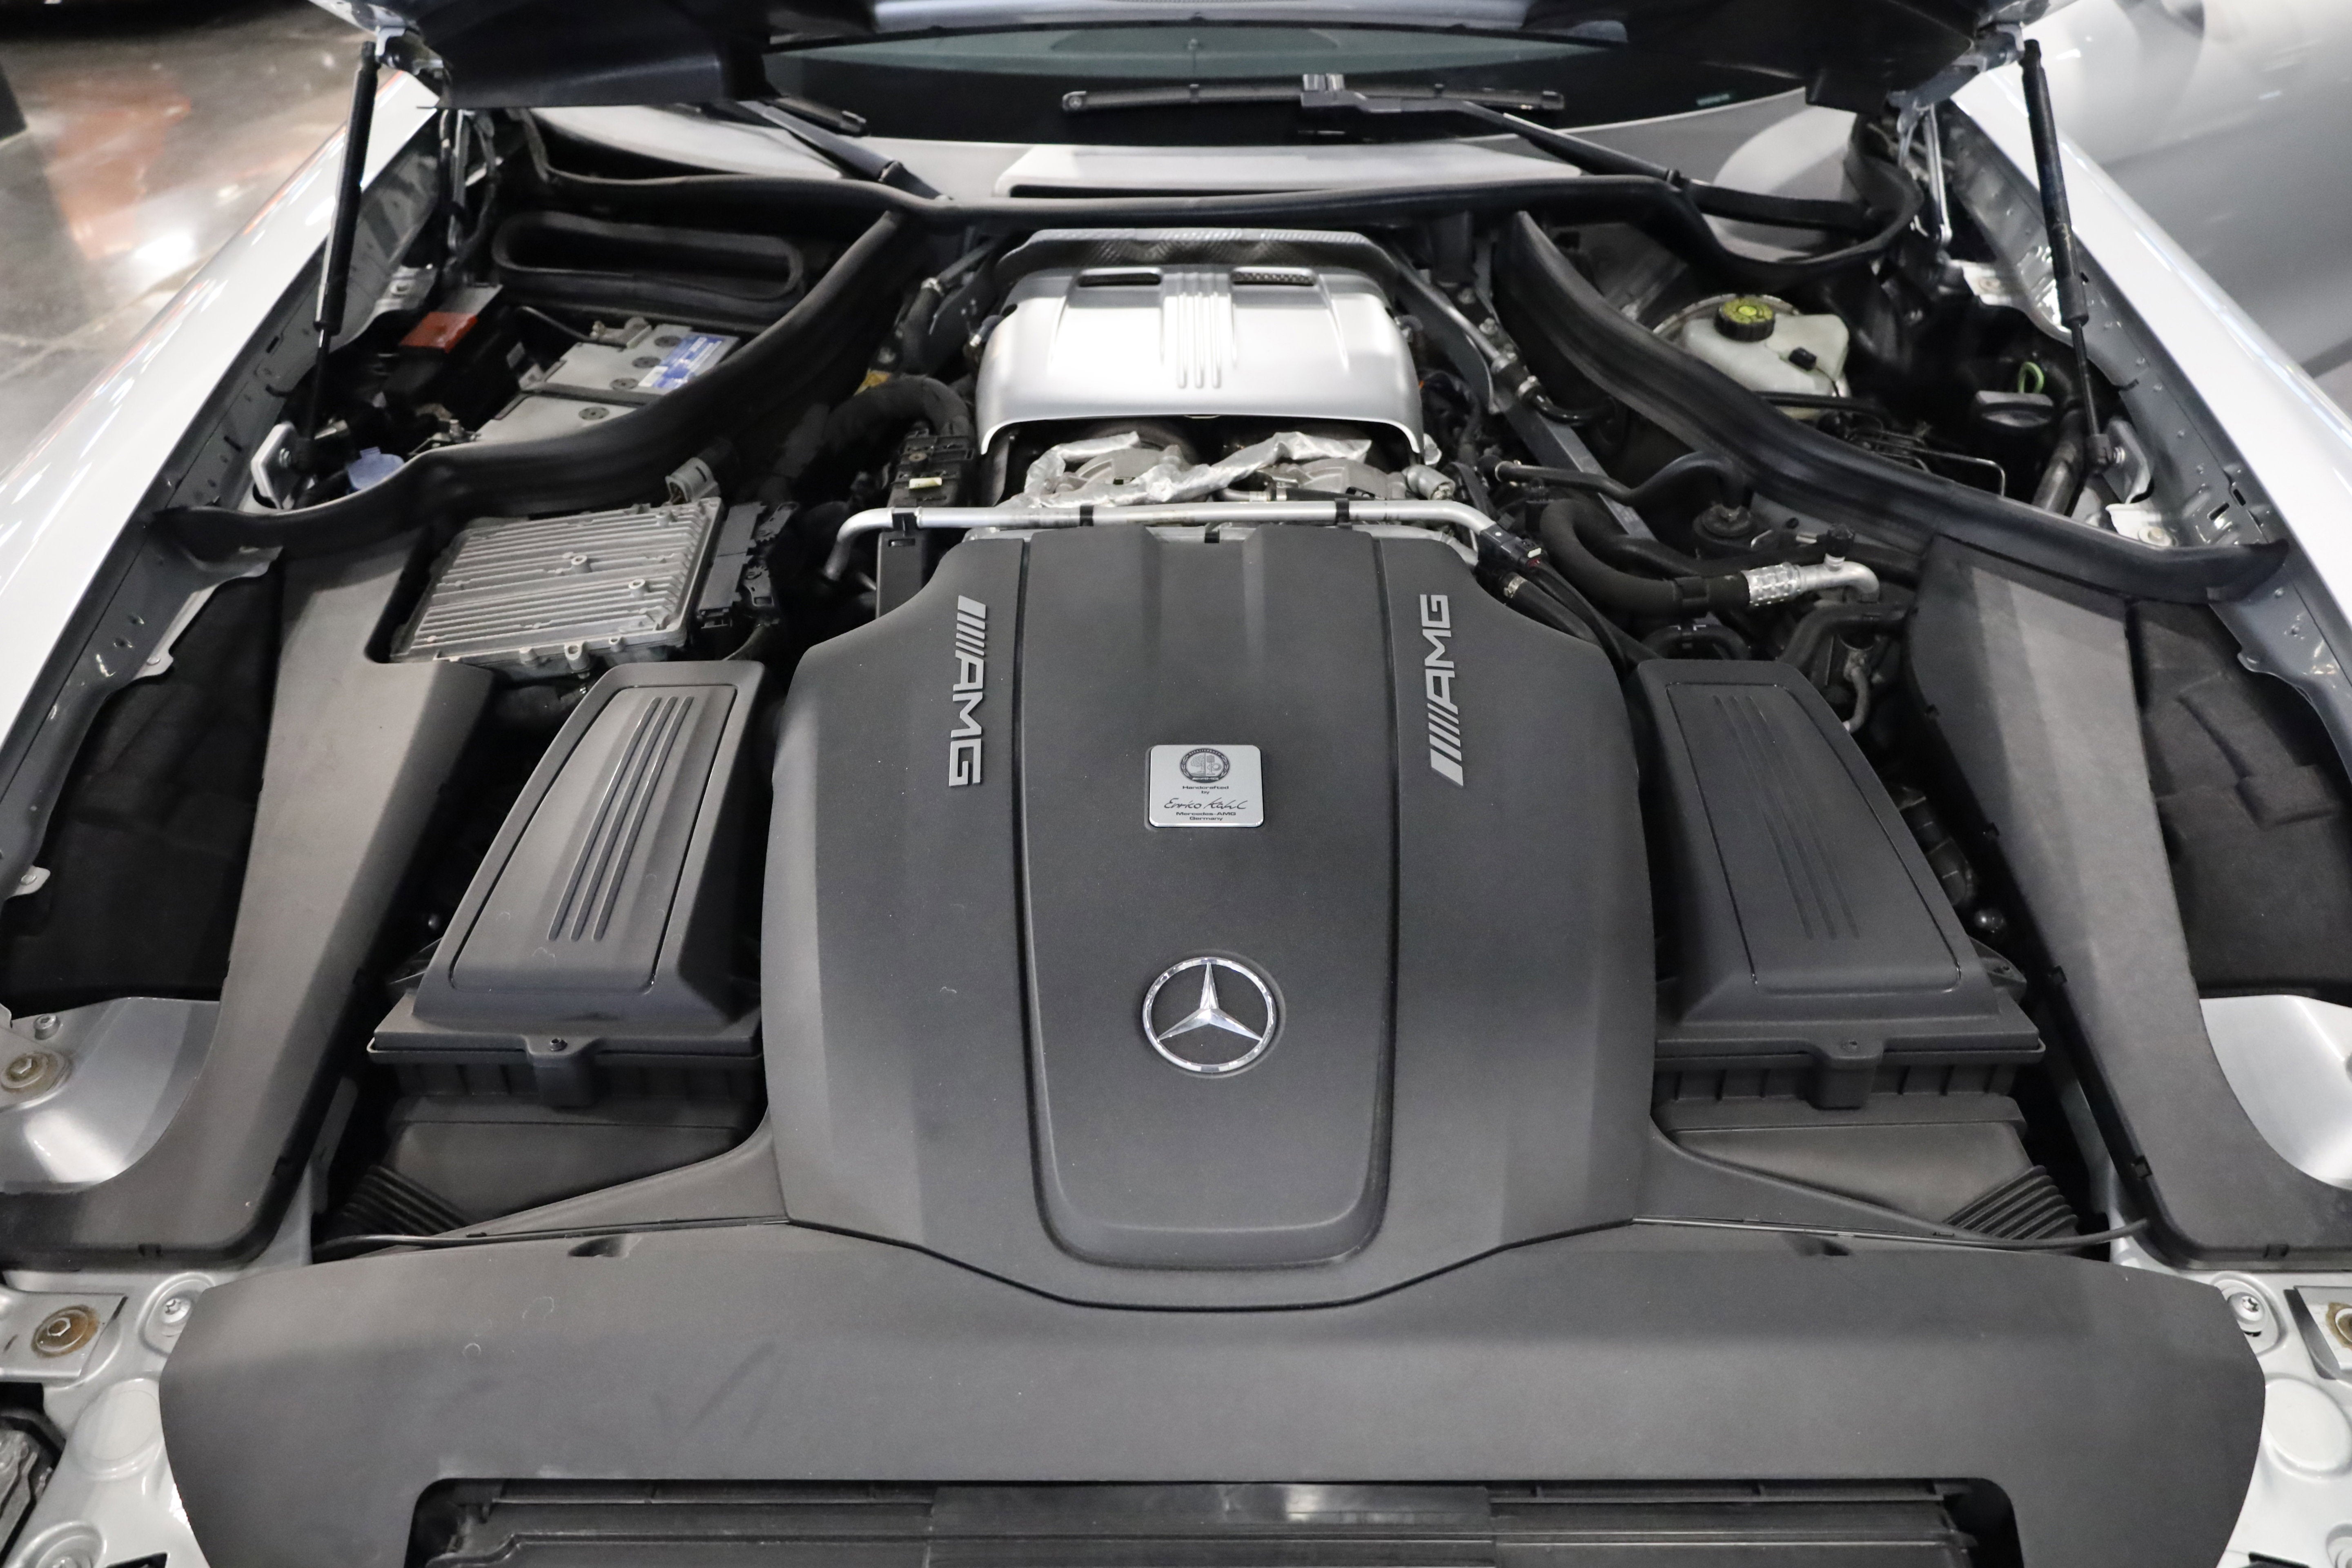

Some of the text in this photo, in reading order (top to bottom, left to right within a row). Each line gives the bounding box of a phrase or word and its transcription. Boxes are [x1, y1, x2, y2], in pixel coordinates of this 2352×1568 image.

[1420, 594, 1458, 715] AMG
[949, 649, 984, 786] AMG
[1164, 798, 1202, 808] Enrico
